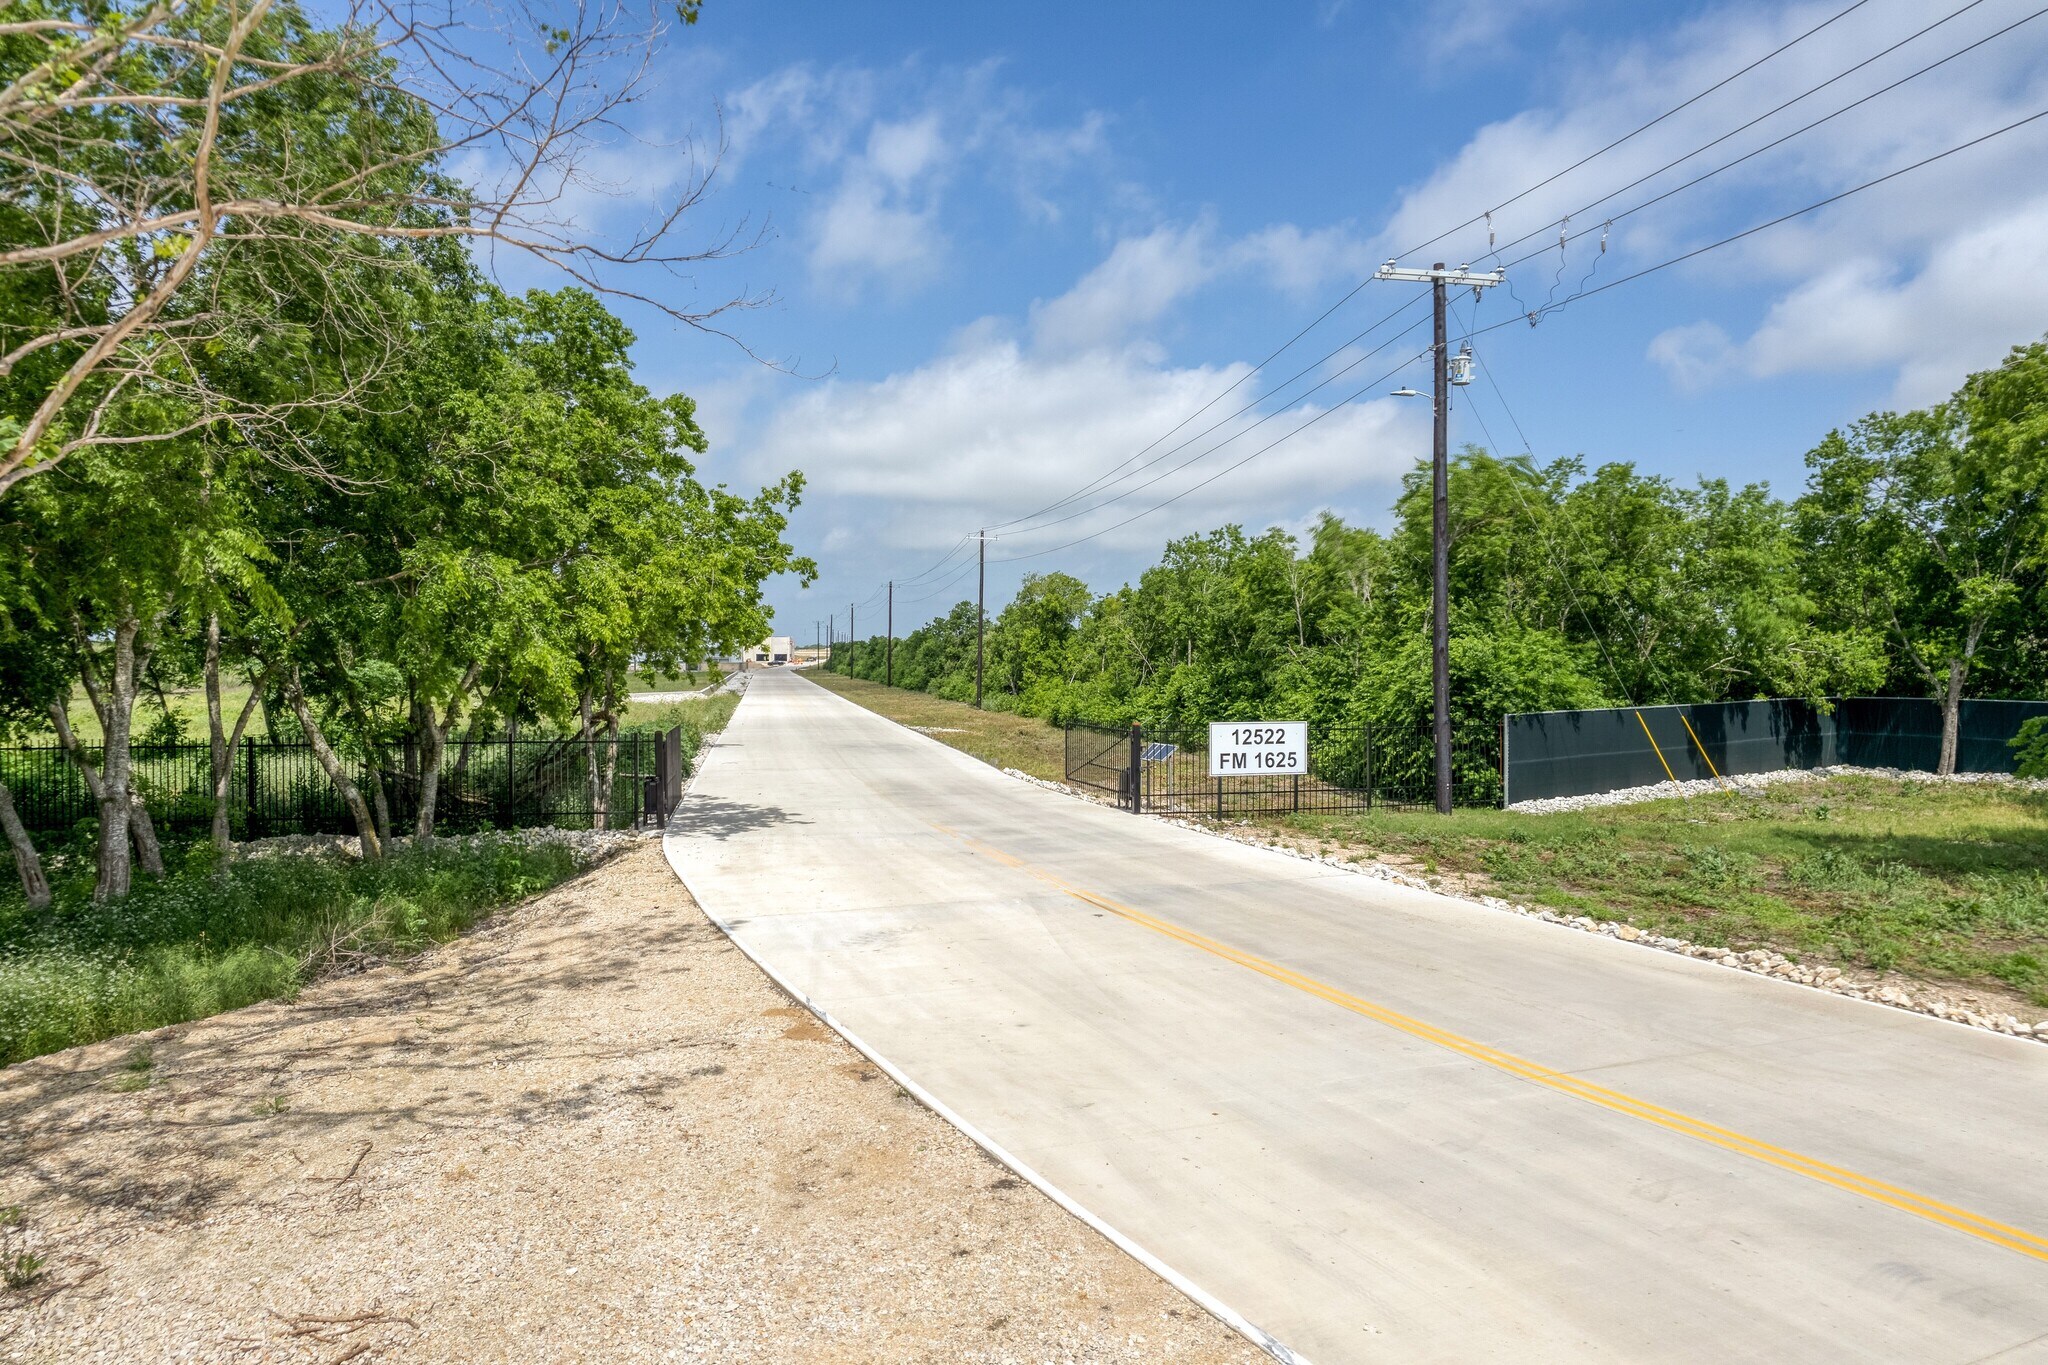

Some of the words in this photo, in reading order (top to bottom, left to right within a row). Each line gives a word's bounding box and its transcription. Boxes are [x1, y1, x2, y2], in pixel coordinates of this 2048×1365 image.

[1231, 728, 1286, 745] 12522
[1219, 752, 1247, 769] FM
[1254, 751, 1297, 768] 1625
